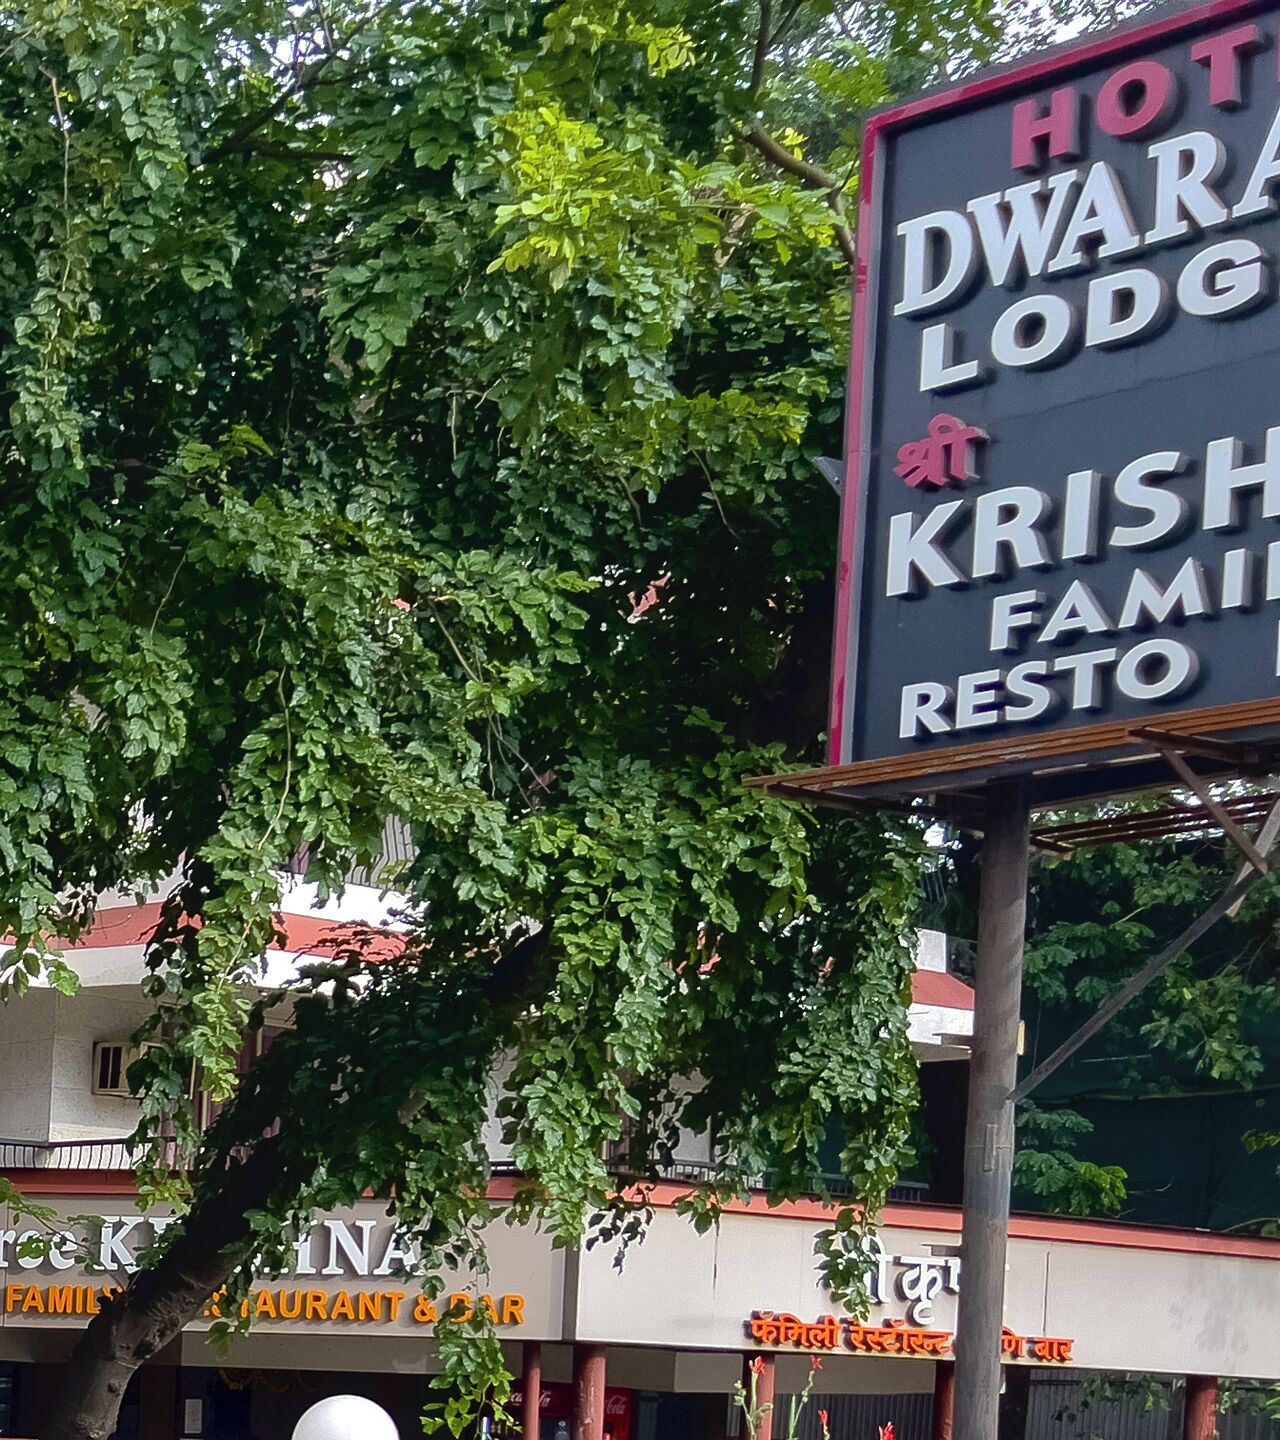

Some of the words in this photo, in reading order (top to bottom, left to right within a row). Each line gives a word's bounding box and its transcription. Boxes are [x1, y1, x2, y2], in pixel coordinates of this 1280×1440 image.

[1010, 23, 1280, 171] HOT
[919, 238, 1265, 393] LODG
[893, 412, 988, 489] श्री
[898, 637, 1195, 739] RESTO
[5, 1283, 124, 1315] FAMIL
[414, 1294, 438, 1323] &
[1032, 1336, 1075, 1361] बार
